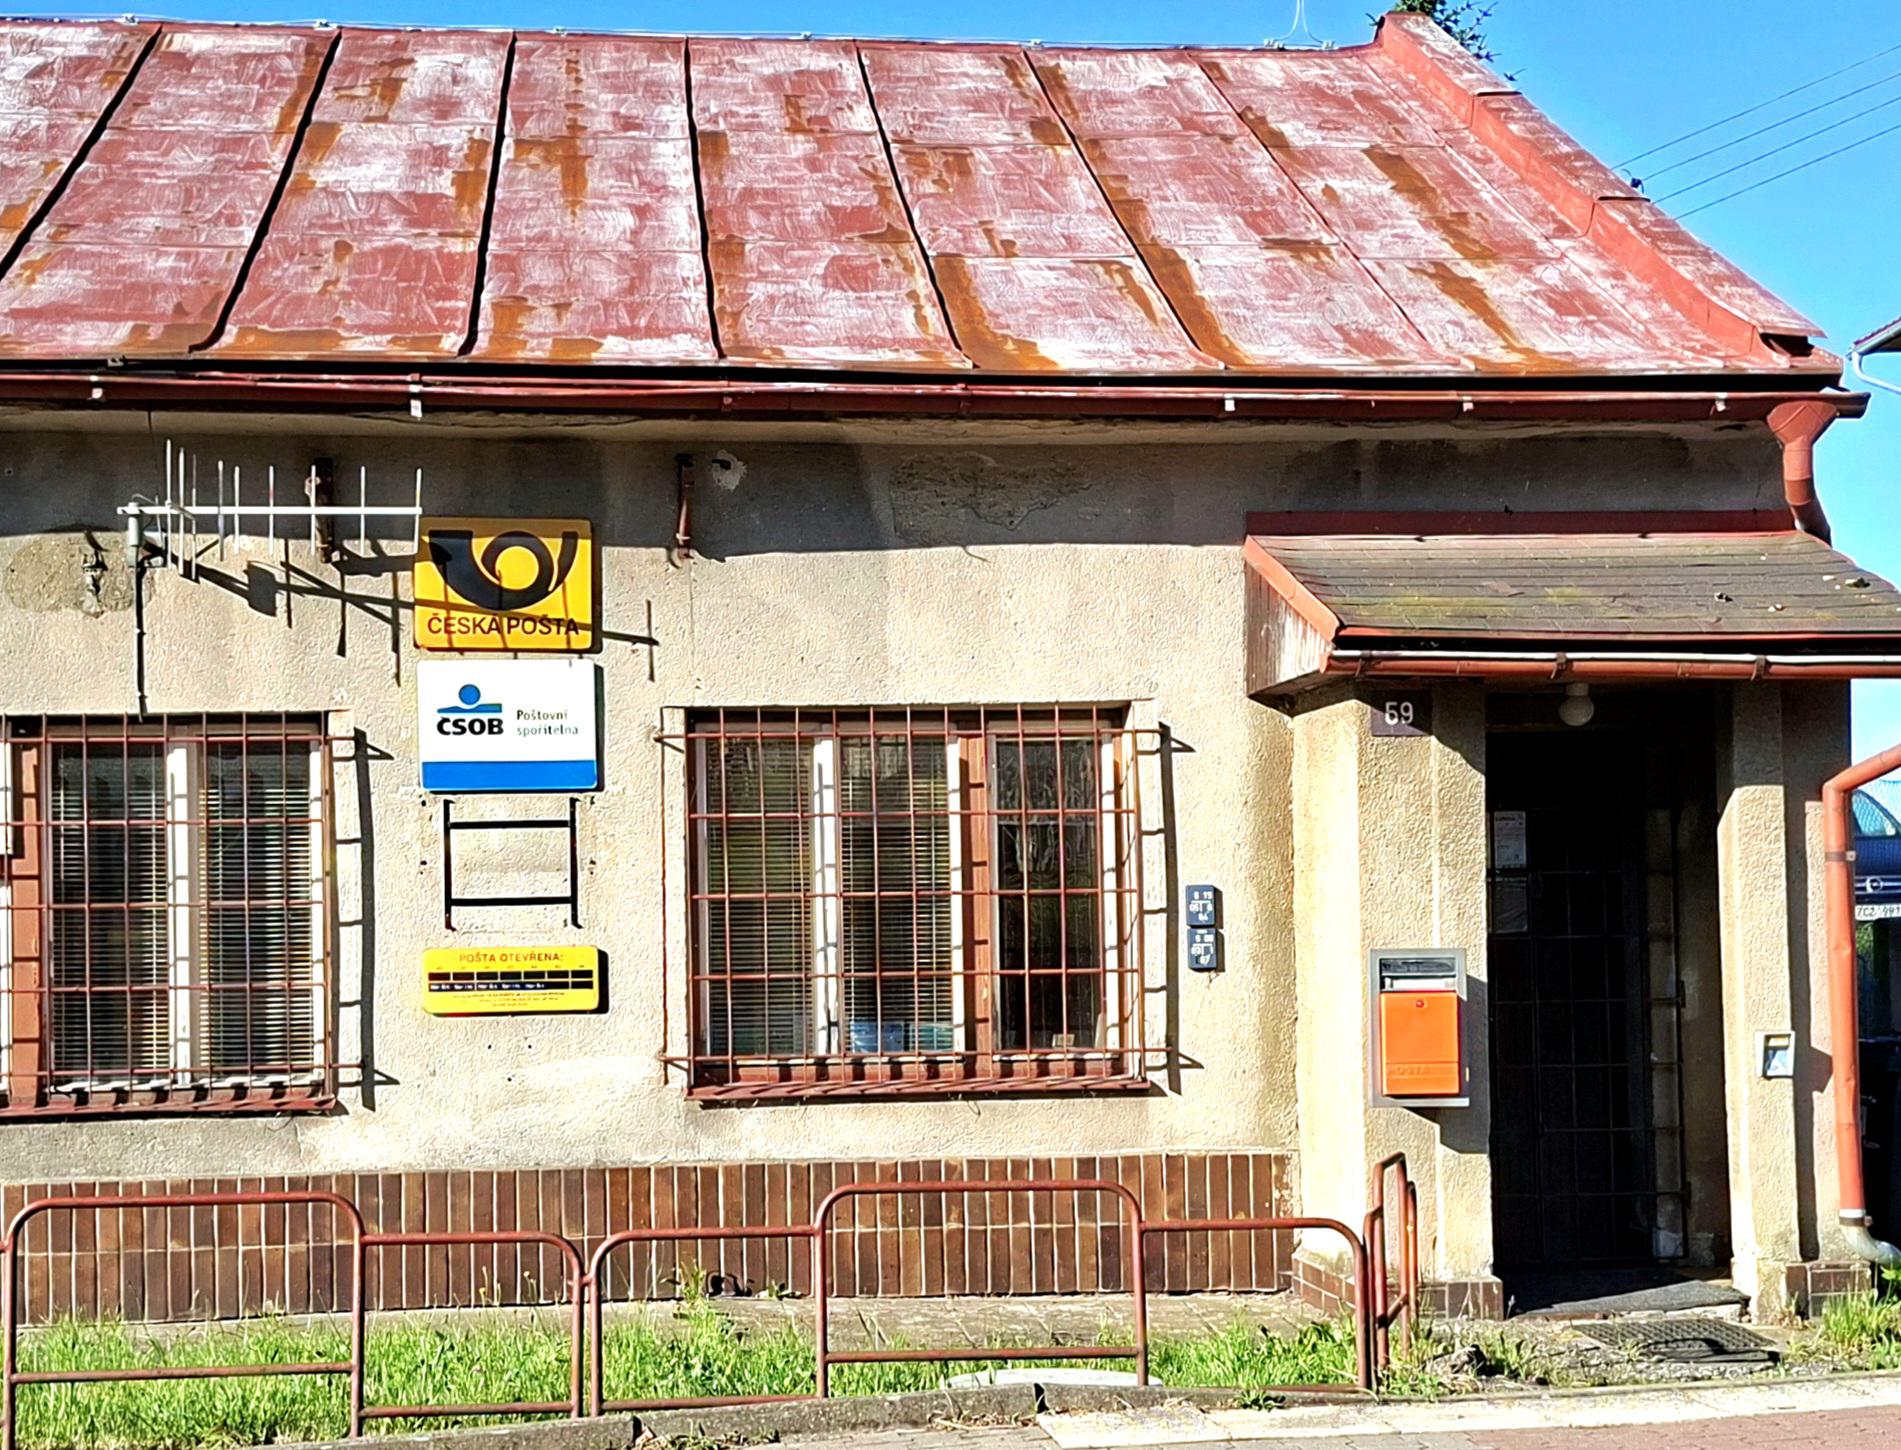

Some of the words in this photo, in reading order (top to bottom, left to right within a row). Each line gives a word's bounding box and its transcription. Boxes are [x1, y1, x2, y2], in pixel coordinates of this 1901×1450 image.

[427, 612, 501, 635] ČESKÁ
[506, 613, 579, 635] POŠTA
[516, 709, 568, 721] Poštovní
[1384, 701, 1413, 726] 59
[436, 716, 504, 736] ČSOB
[516, 723, 579, 738] spořitelna
[459, 952, 496, 963] POŠTA
